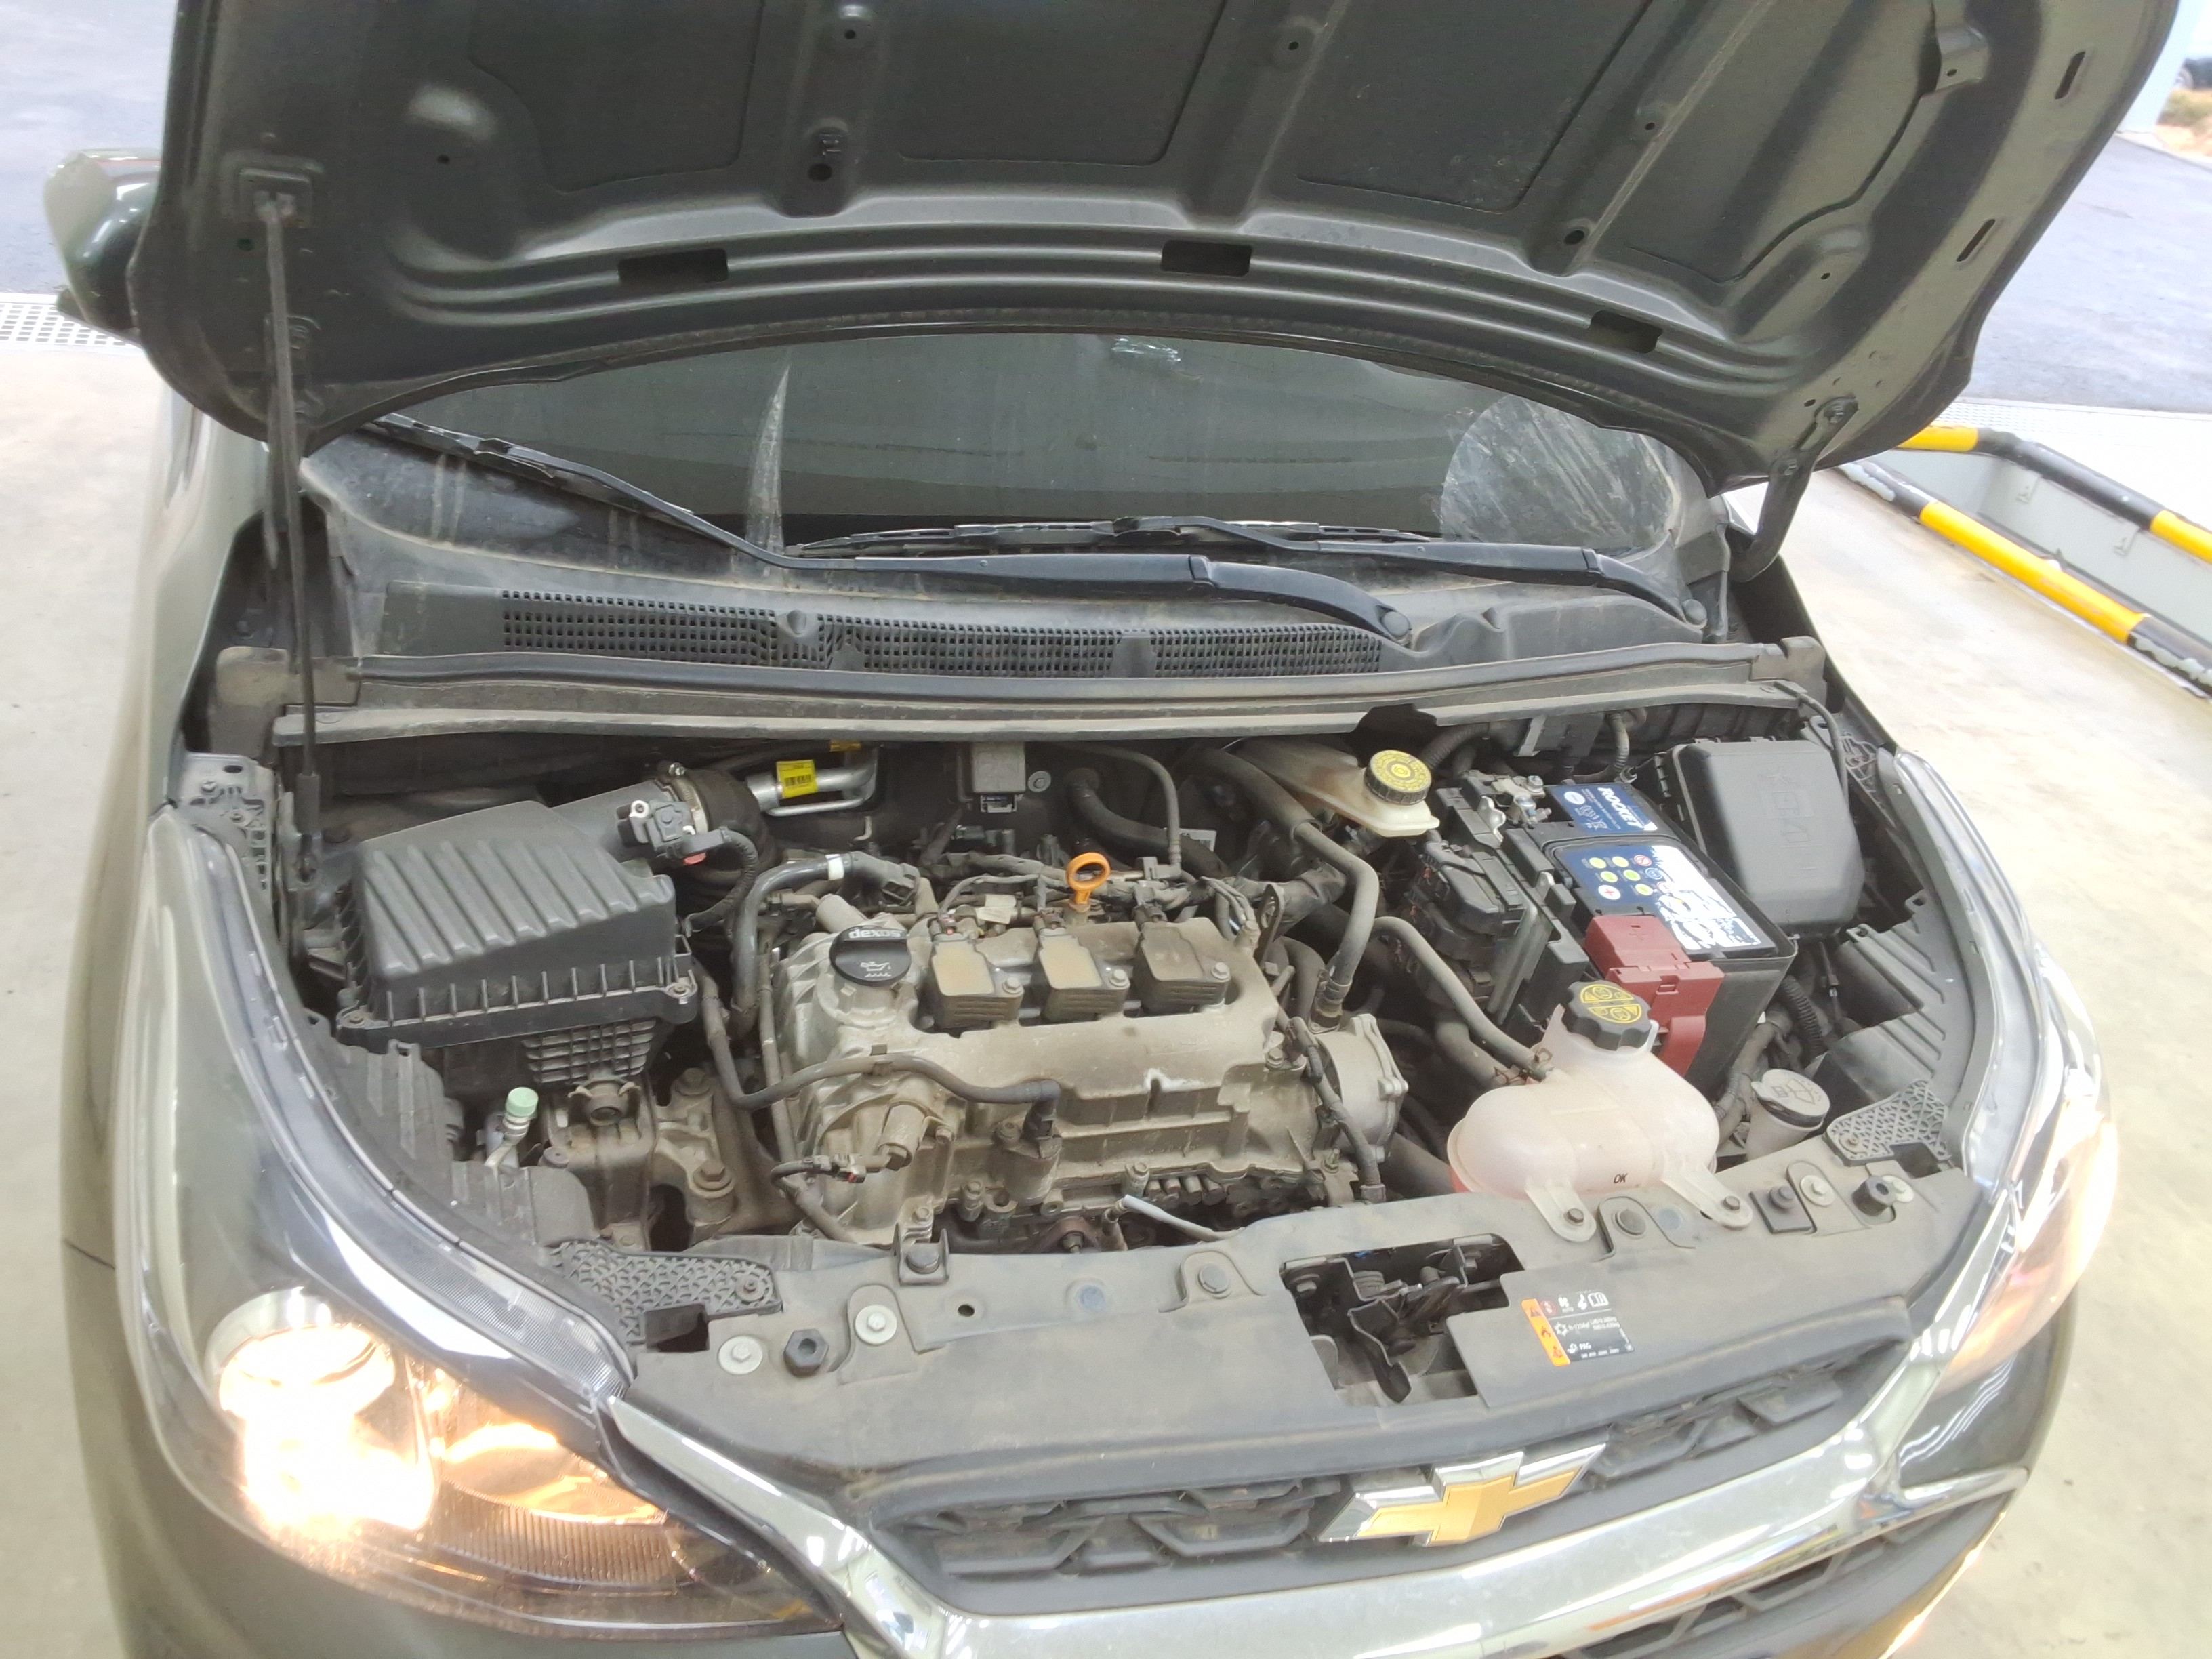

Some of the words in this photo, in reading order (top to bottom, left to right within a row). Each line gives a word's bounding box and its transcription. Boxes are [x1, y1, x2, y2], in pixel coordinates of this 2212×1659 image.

[1597, 787, 1644, 828] ROCKET
[849, 928, 901, 939] dexos
[1614, 1173, 1628, 1183] OK
